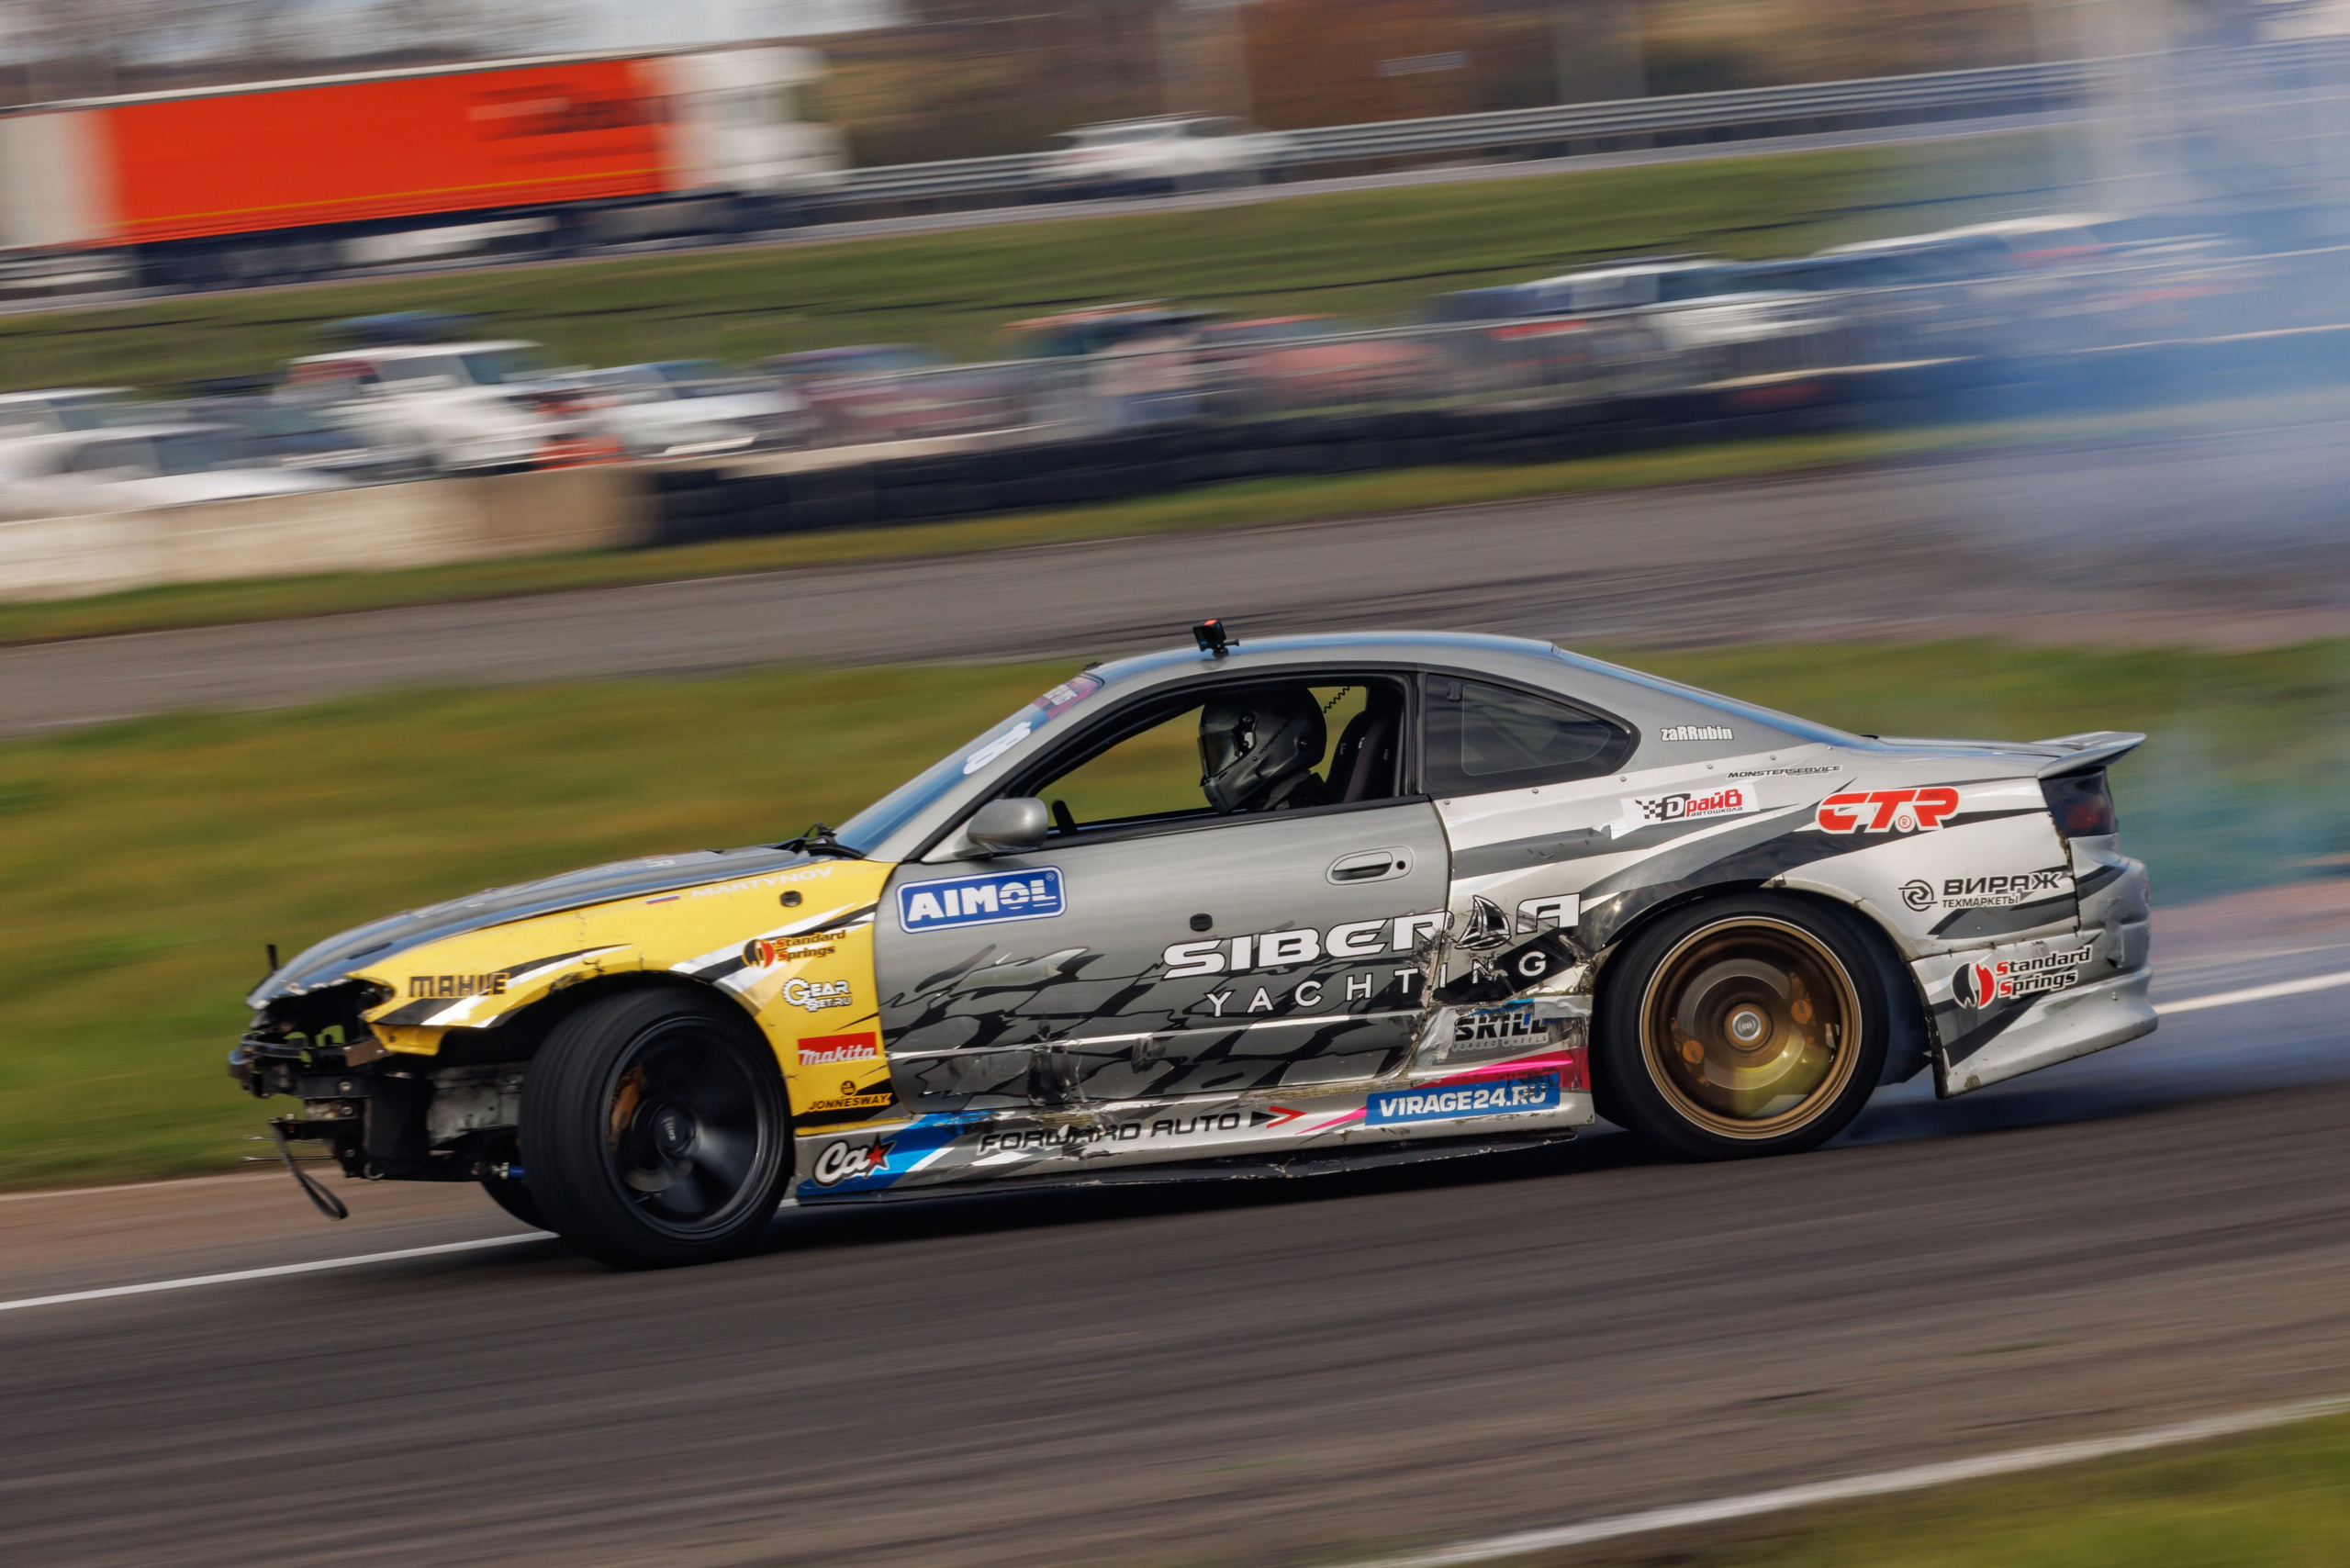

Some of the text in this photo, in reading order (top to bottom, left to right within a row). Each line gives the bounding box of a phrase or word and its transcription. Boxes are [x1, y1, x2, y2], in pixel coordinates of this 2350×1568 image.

[1661, 726, 1734, 742] zaRRubin
[1690, 806, 1743, 817] автошкола
[1818, 787, 1959, 832] CTR
[690, 866, 834, 898] MARTYNOV
[1943, 873, 2061, 896] ВИРАЖ
[907, 879, 1058, 923] AIMOL
[1942, 894, 2019, 909] ТЕХМАРКЕТЫ
[776, 929, 847, 948] Standard
[778, 946, 836, 962] Springs
[1996, 946, 2091, 977] Standard
[409, 974, 507, 998] MAHLE
[1203, 950, 1548, 1018] YACHTING
[1999, 971, 2076, 997] Springs
[1454, 1013, 1549, 1042] SKILL
[798, 1044, 878, 1066] makita
[1453, 1036, 1548, 1050] FORGED WHEELS
[809, 1093, 890, 1111] JONNESWAY
[1379, 1083, 1548, 1117] VIRAGE24.RU
[1150, 1112, 1241, 1137] AUTO
